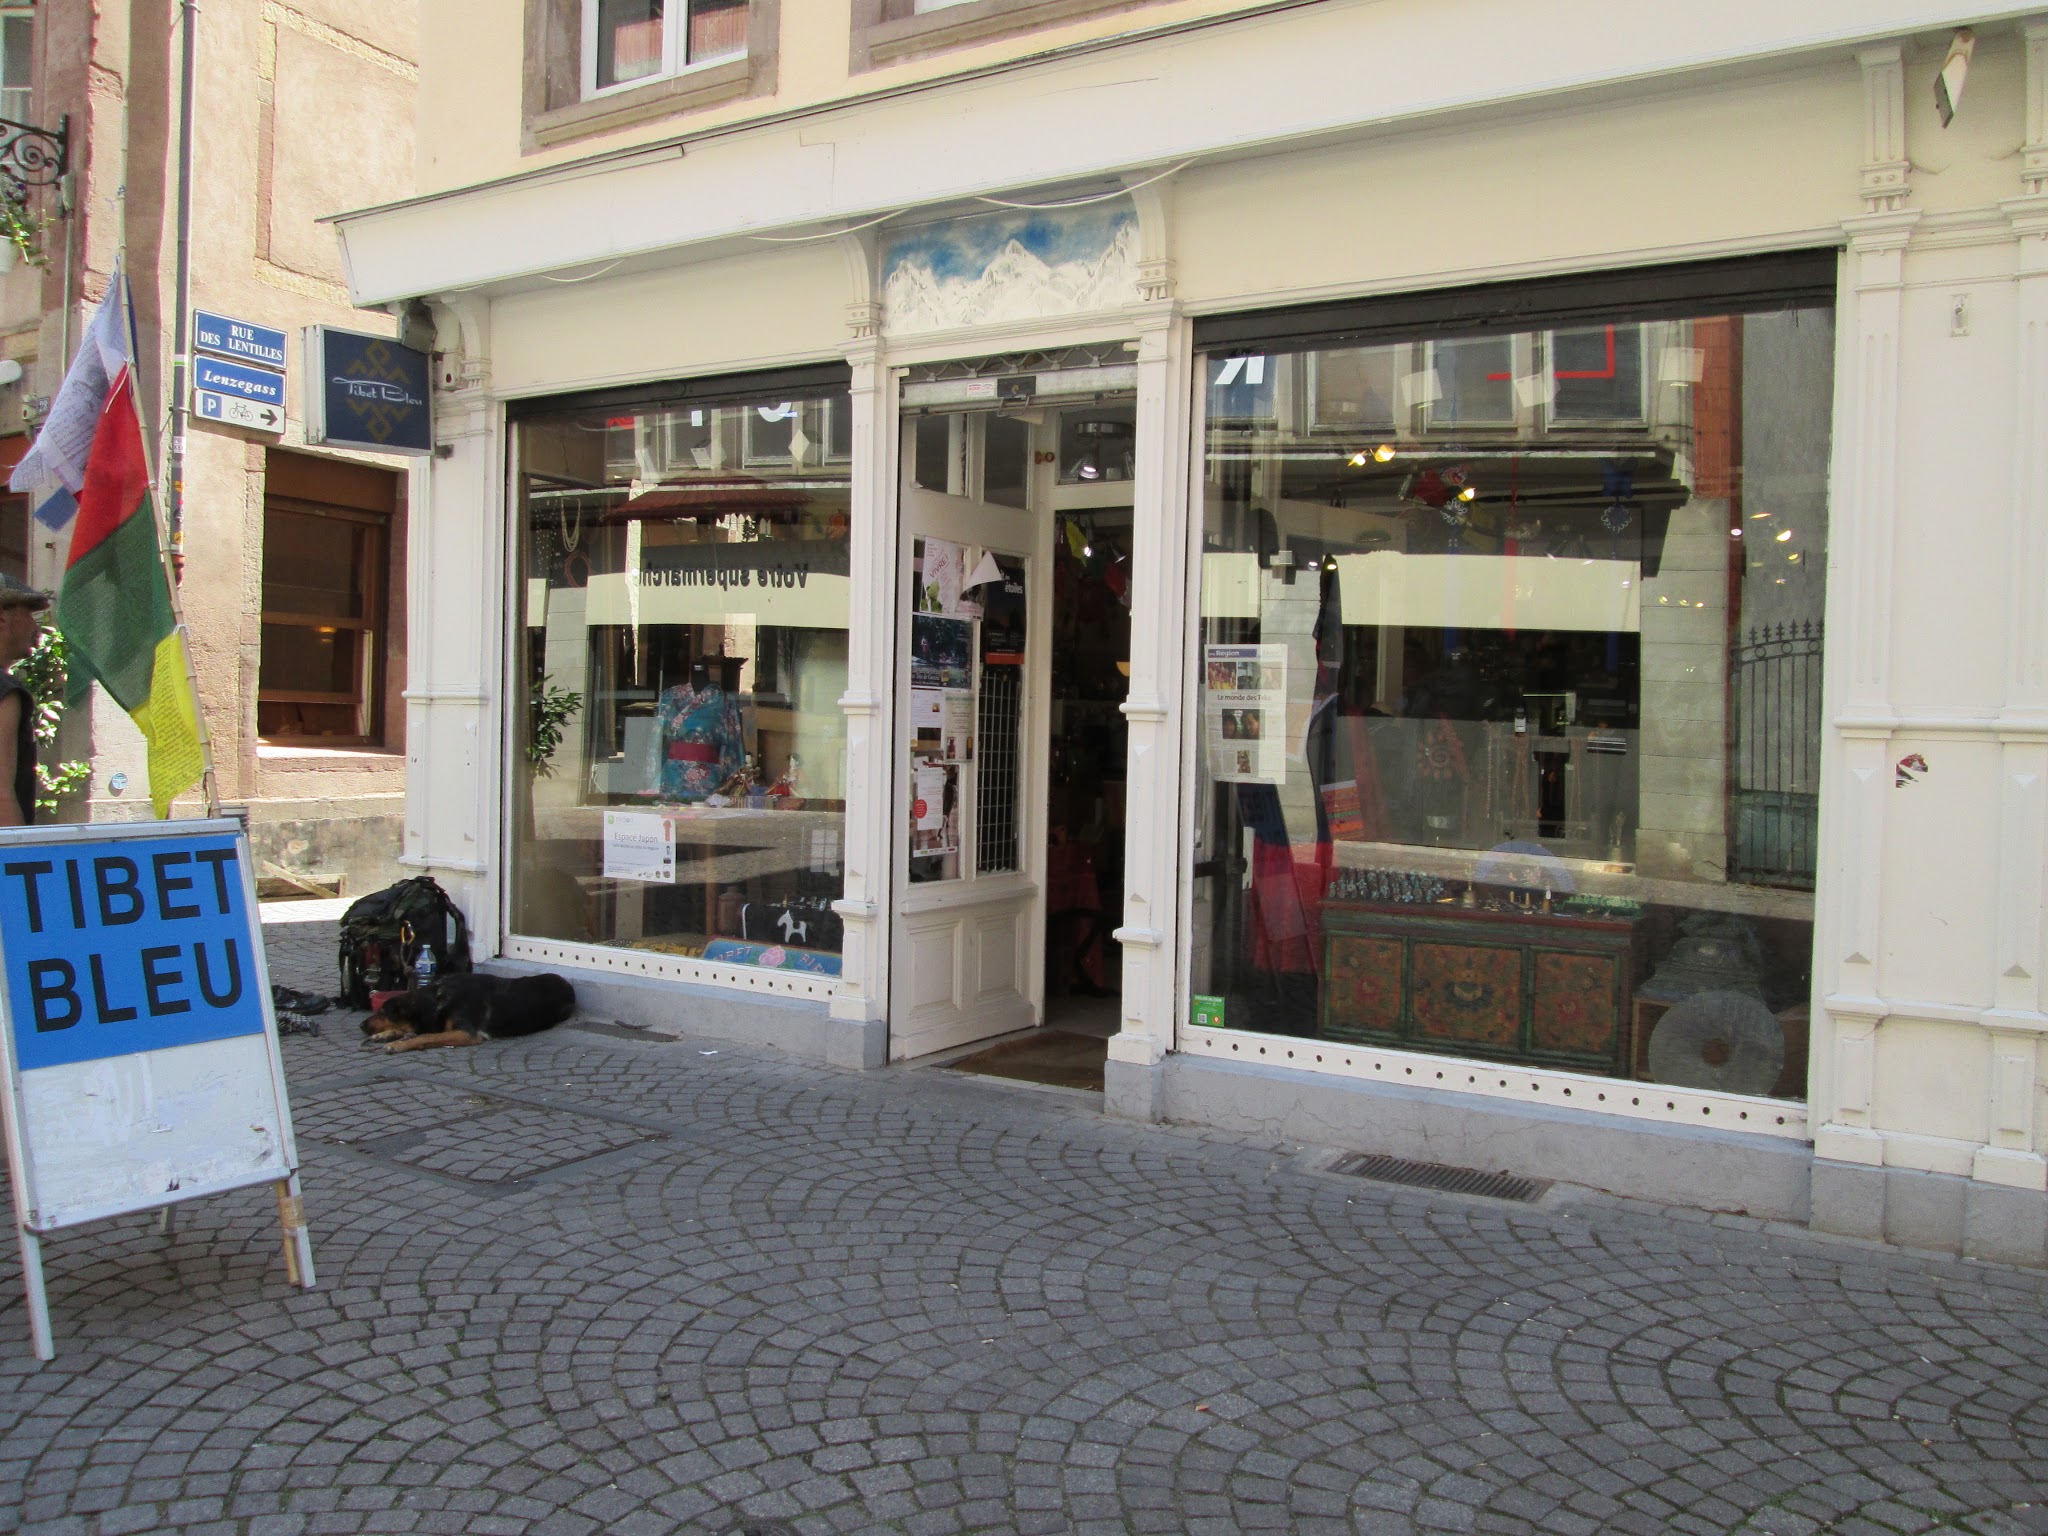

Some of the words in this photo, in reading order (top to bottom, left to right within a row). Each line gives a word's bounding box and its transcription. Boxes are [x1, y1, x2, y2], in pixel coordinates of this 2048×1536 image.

[200, 330, 221, 346] DES
[228, 338, 283, 361] LENTILLES
[231, 324, 254, 341] RUE
[203, 370, 277, 396] Lenzegass
[332, 377, 378, 399] Tibet
[381, 383, 423, 405] Bleu
[206, 398, 217, 412] P
[614, 832, 637, 843] Espace
[638, 834, 659, 844] Japon
[4, 847, 238, 934] TIBET
[27, 937, 244, 1033] BLEU
